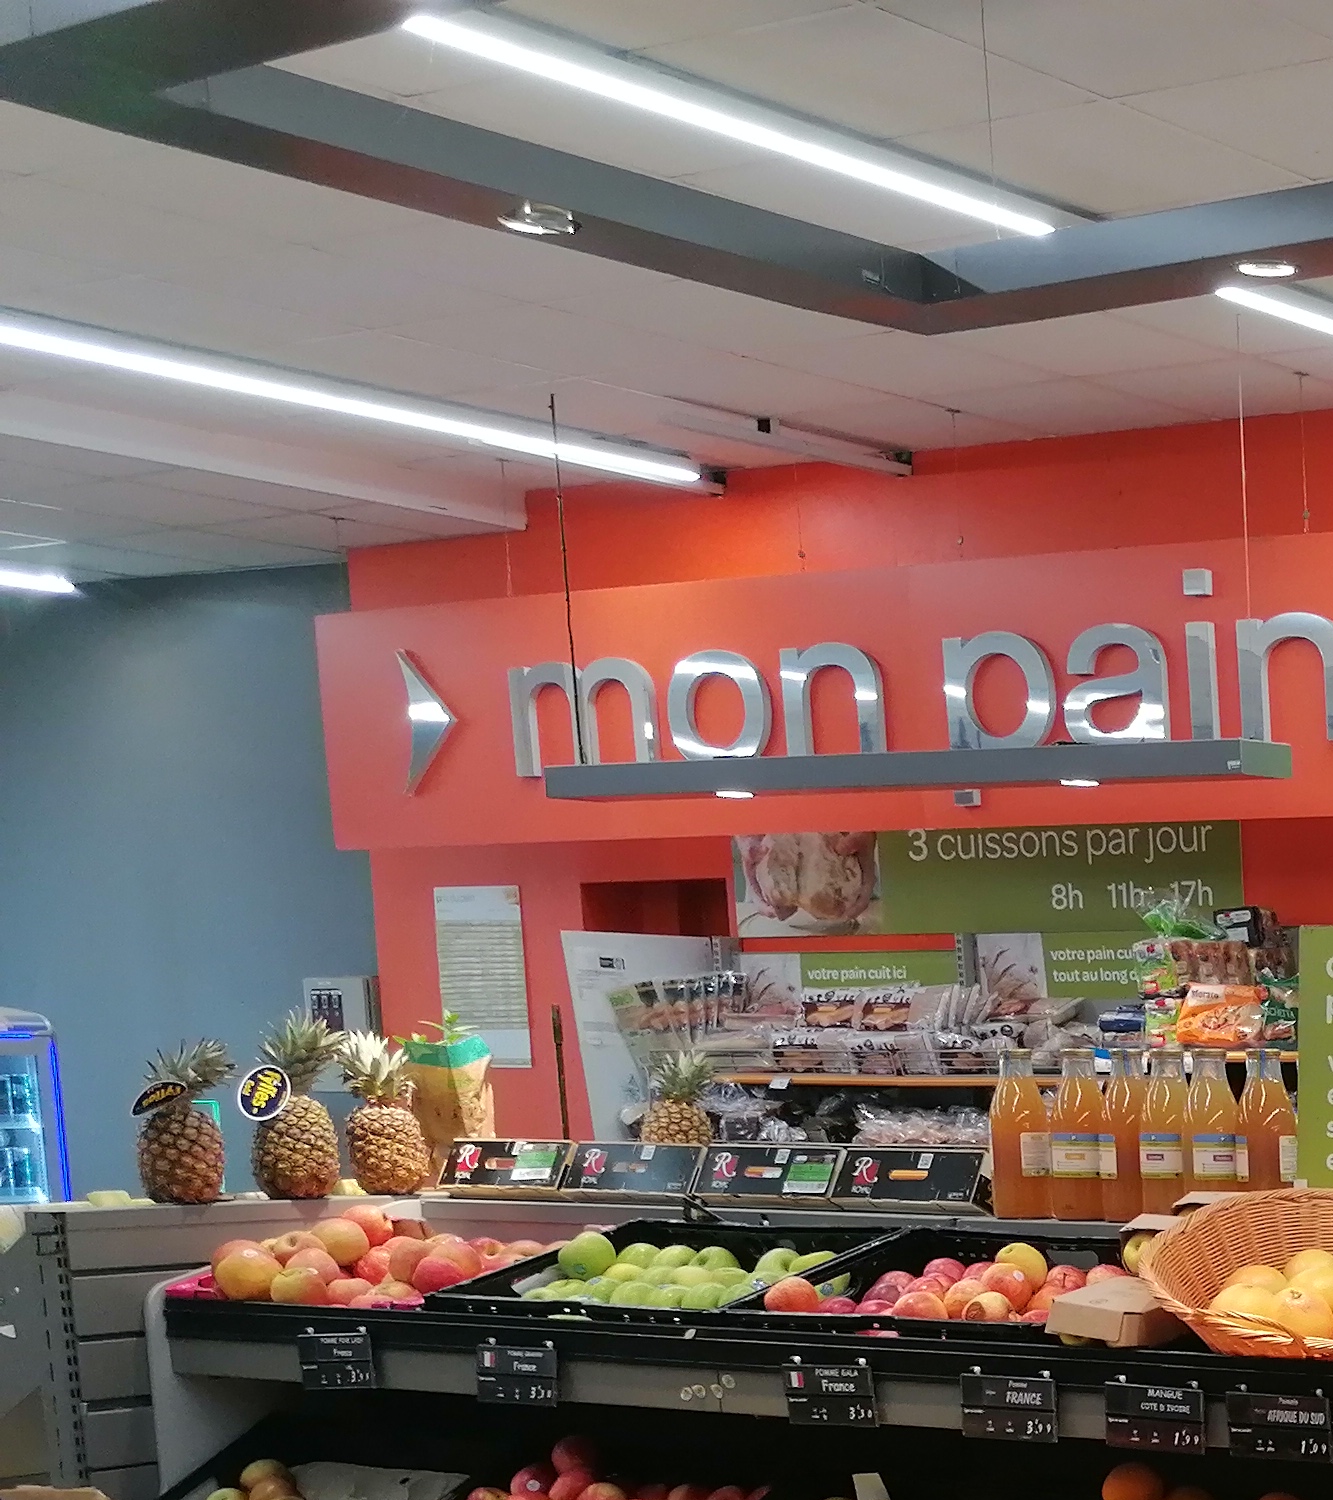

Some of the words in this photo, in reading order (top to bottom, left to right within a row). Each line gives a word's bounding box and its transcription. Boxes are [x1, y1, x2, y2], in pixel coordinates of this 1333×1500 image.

[506, 641, 887, 778] mon
[908, 828, 930, 862] 3
[937, 828, 1079, 861] cuissons
[1087, 828, 1139, 865] par
[1145, 824, 1211, 864] jour
[1051, 884, 1084, 911] 8h
[1170, 878, 1214, 909] 17h
[1049, 947, 1085, 962] votre
[1087, 945, 1115, 965] pain
[807, 968, 839, 980] votre
[840, 966, 867, 982] pain
[868, 966, 892, 980] cuit
[893, 965, 907, 979] ici
[1053, 967, 1080, 983] tout
[1081, 970, 1098, 982] au
[1099, 967, 1126, 986] long
[821, 1379, 856, 1392] France
[1147, 1388, 1183, 1400] MANGUE
[1006, 1391, 1043, 1405] FRANCE
[1310, 1412, 1326, 1425] SUD
